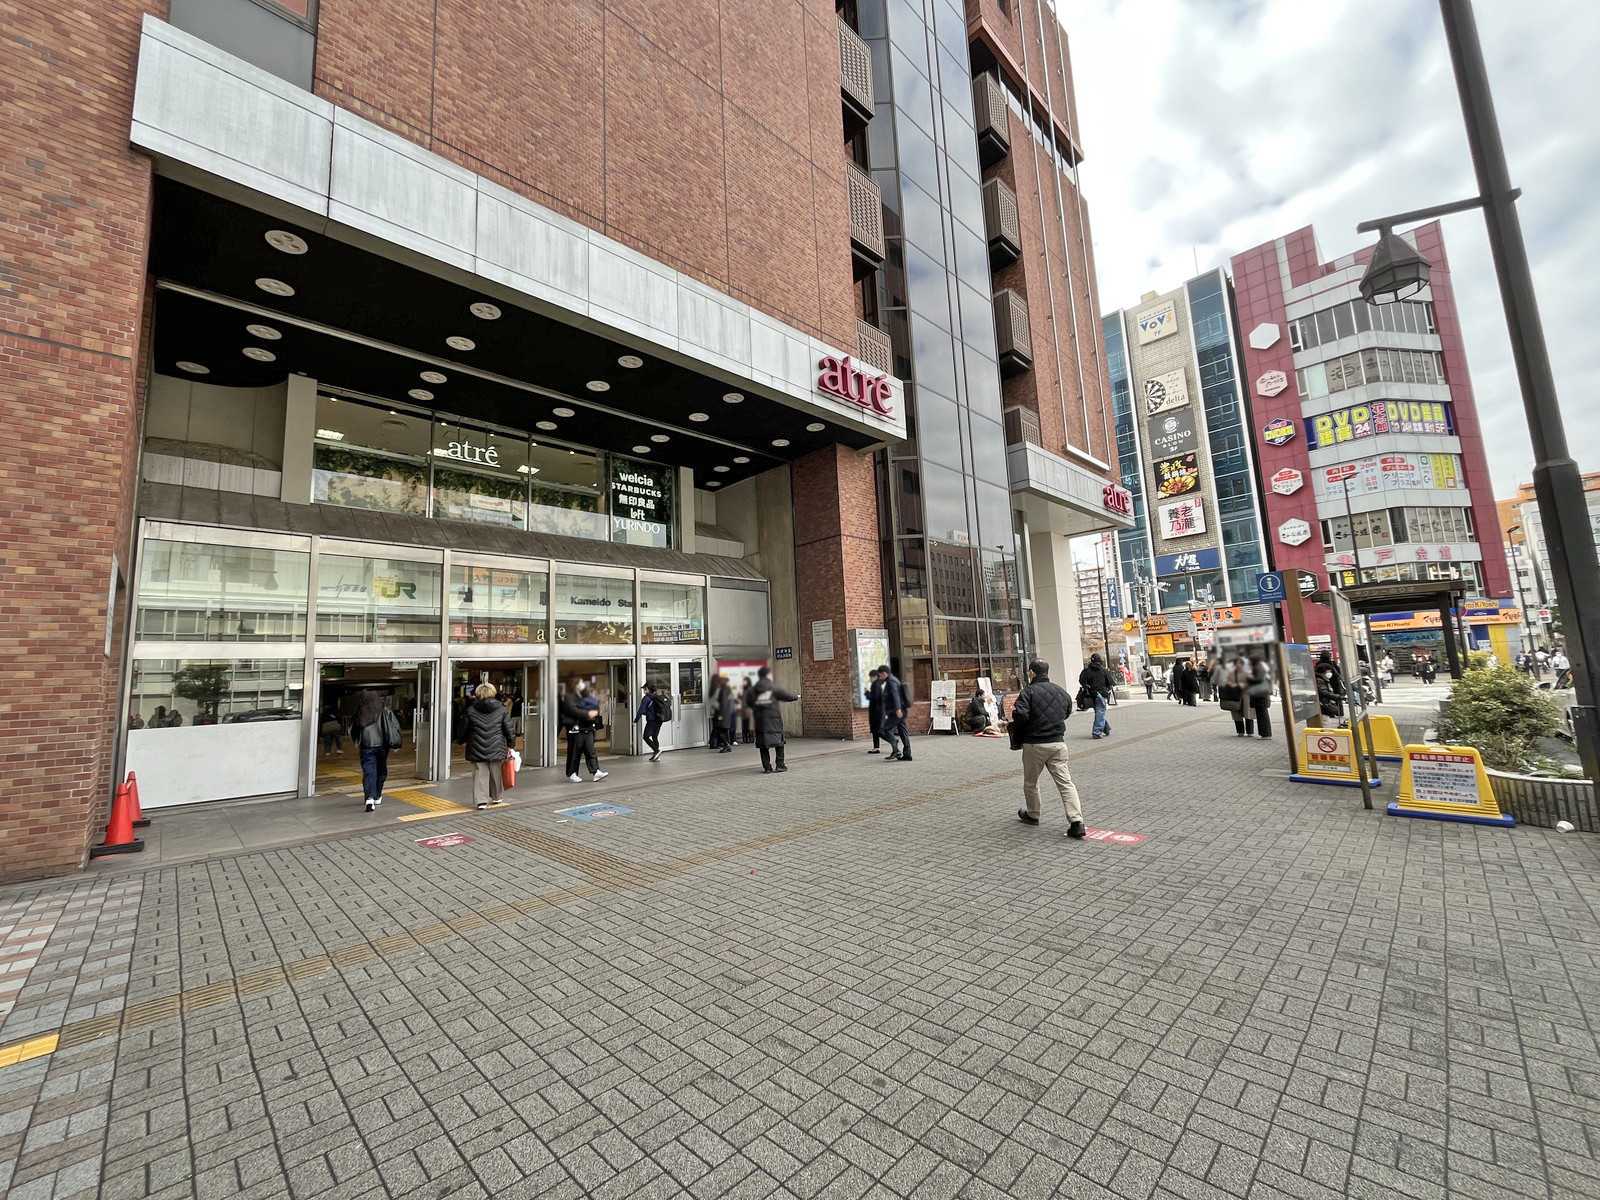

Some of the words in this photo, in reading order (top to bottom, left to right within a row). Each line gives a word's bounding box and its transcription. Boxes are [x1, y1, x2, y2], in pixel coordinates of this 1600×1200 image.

[817, 355, 893, 414] atré
[1166, 395, 1185, 405] delta
[1154, 429, 1191, 446] CASINO
[447, 440, 499, 465] atré
[619, 472, 653, 487] welcia
[612, 482, 662, 498] STARBUCKS
[619, 494, 655, 509] 無印良品
[613, 518, 660, 534] YURINDO
[571, 596, 611, 607] Kameido
